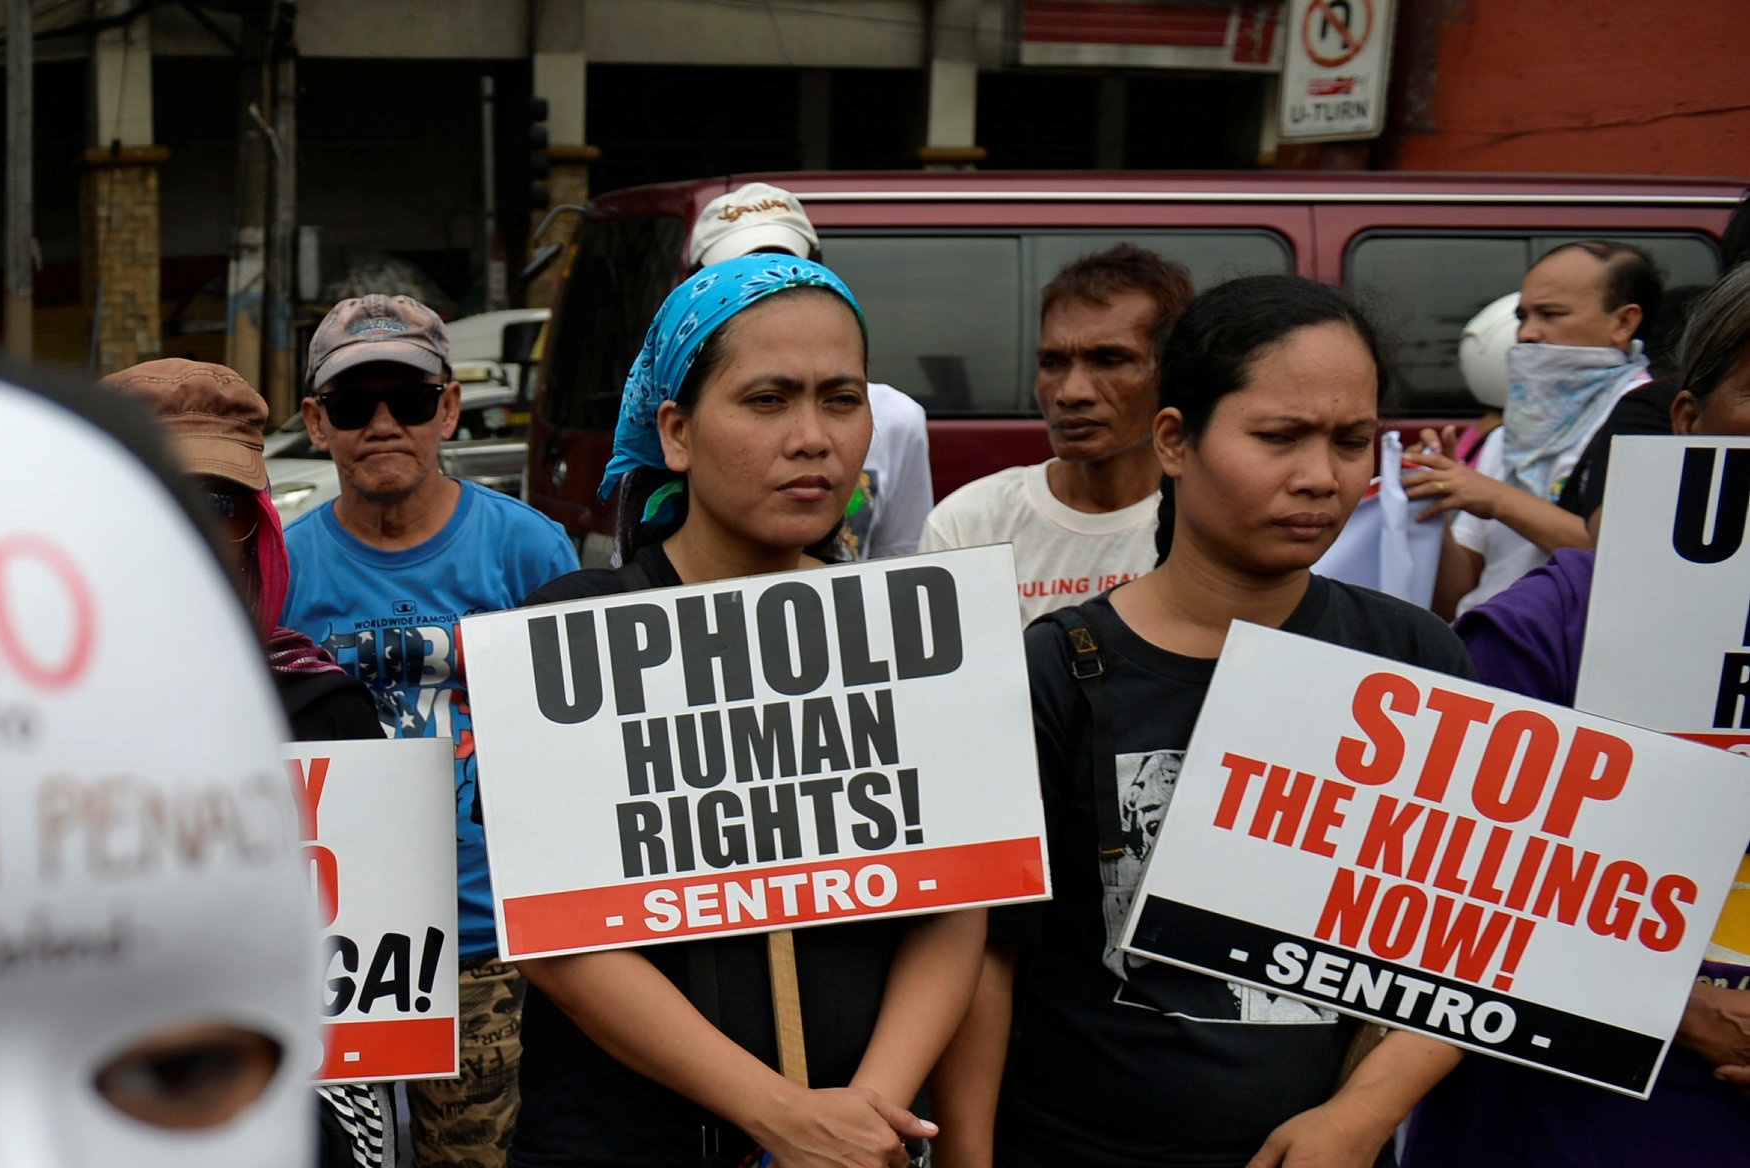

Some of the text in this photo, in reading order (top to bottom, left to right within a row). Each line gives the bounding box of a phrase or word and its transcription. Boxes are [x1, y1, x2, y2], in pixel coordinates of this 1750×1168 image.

[1290, 101, 1367, 124] U-TURN
[354, 613, 458, 630] WORLDWIDE FAMOUS
[1018, 578, 1090, 598] ULING
[527, 566, 963, 724] UPHOLD
[621, 689, 899, 796] HUMAN
[1335, 672, 1634, 838] STOP
[616, 767, 924, 878] RIGHTS!
[1214, 752, 1698, 952] THE KILLINGS
[643, 863, 898, 932] SENTRO
[1314, 867, 1537, 992] NOW!
[1265, 942, 1517, 1044] SENTRO
